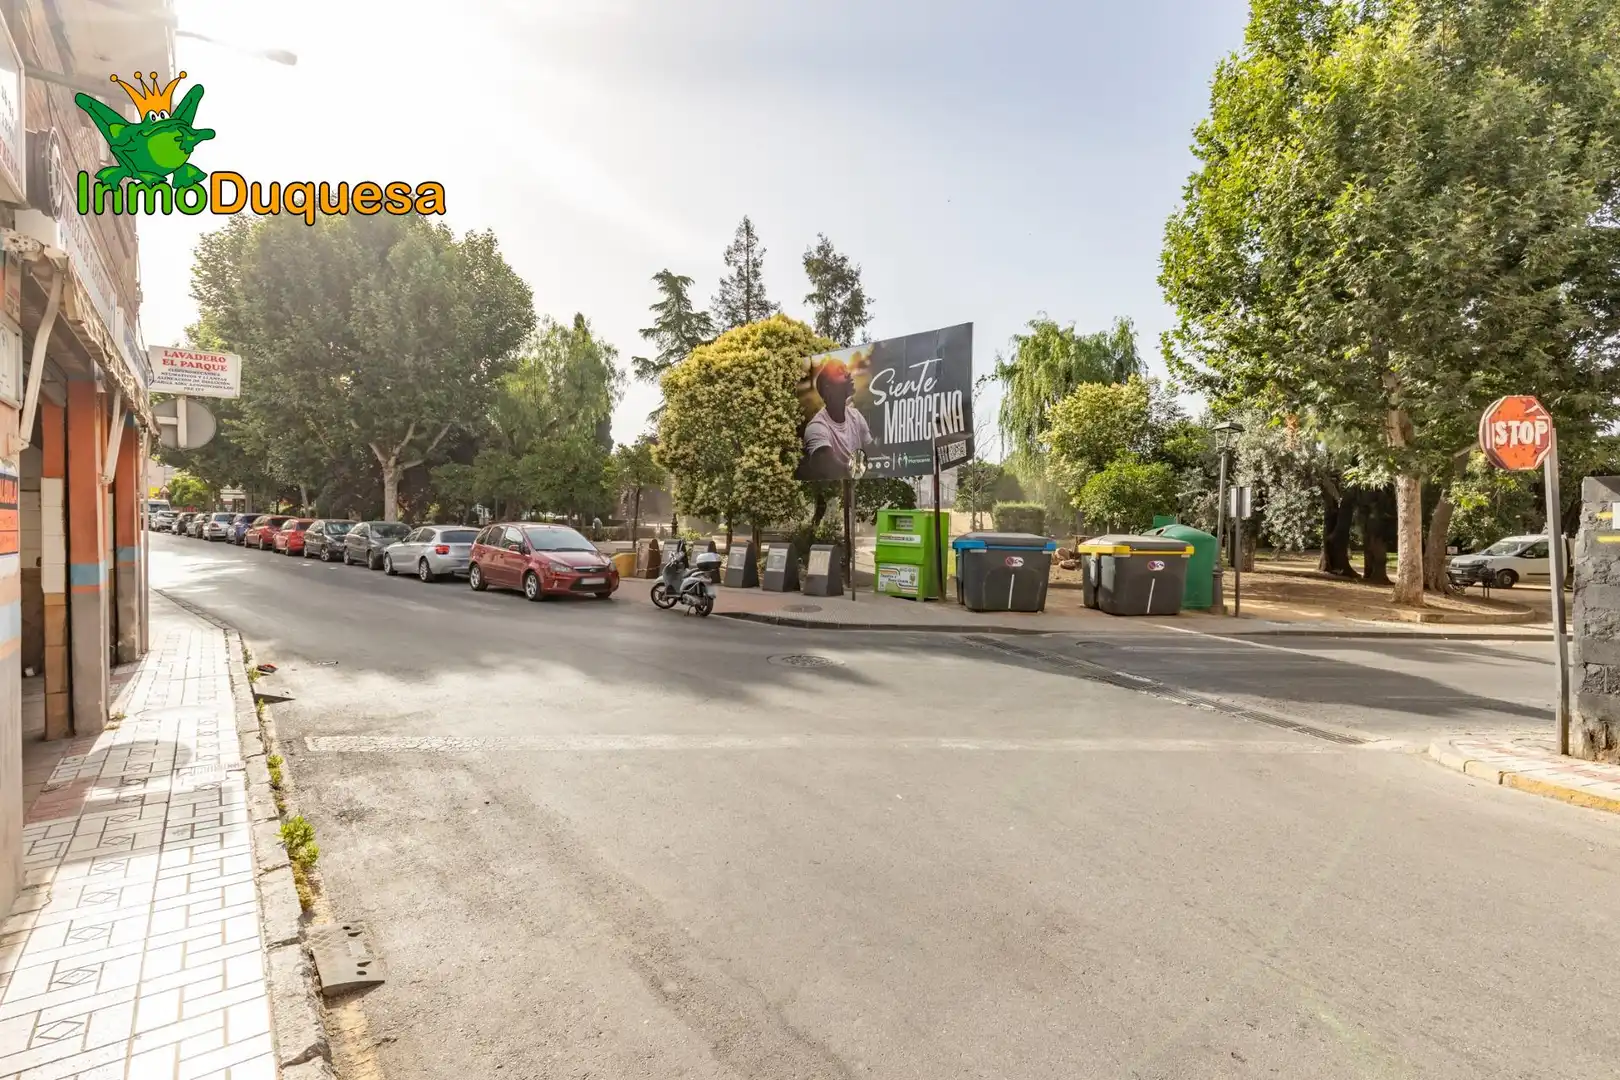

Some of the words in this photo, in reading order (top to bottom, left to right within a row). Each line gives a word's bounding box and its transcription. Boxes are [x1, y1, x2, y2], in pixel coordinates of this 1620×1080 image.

[162, 358, 177, 367] EL
[180, 360, 228, 372] PARQUE
[163, 350, 226, 363] LAVADERO
[868, 358, 943, 406] Siente
[883, 390, 965, 445] MARACENA
[1494, 420, 1549, 447] STOP
